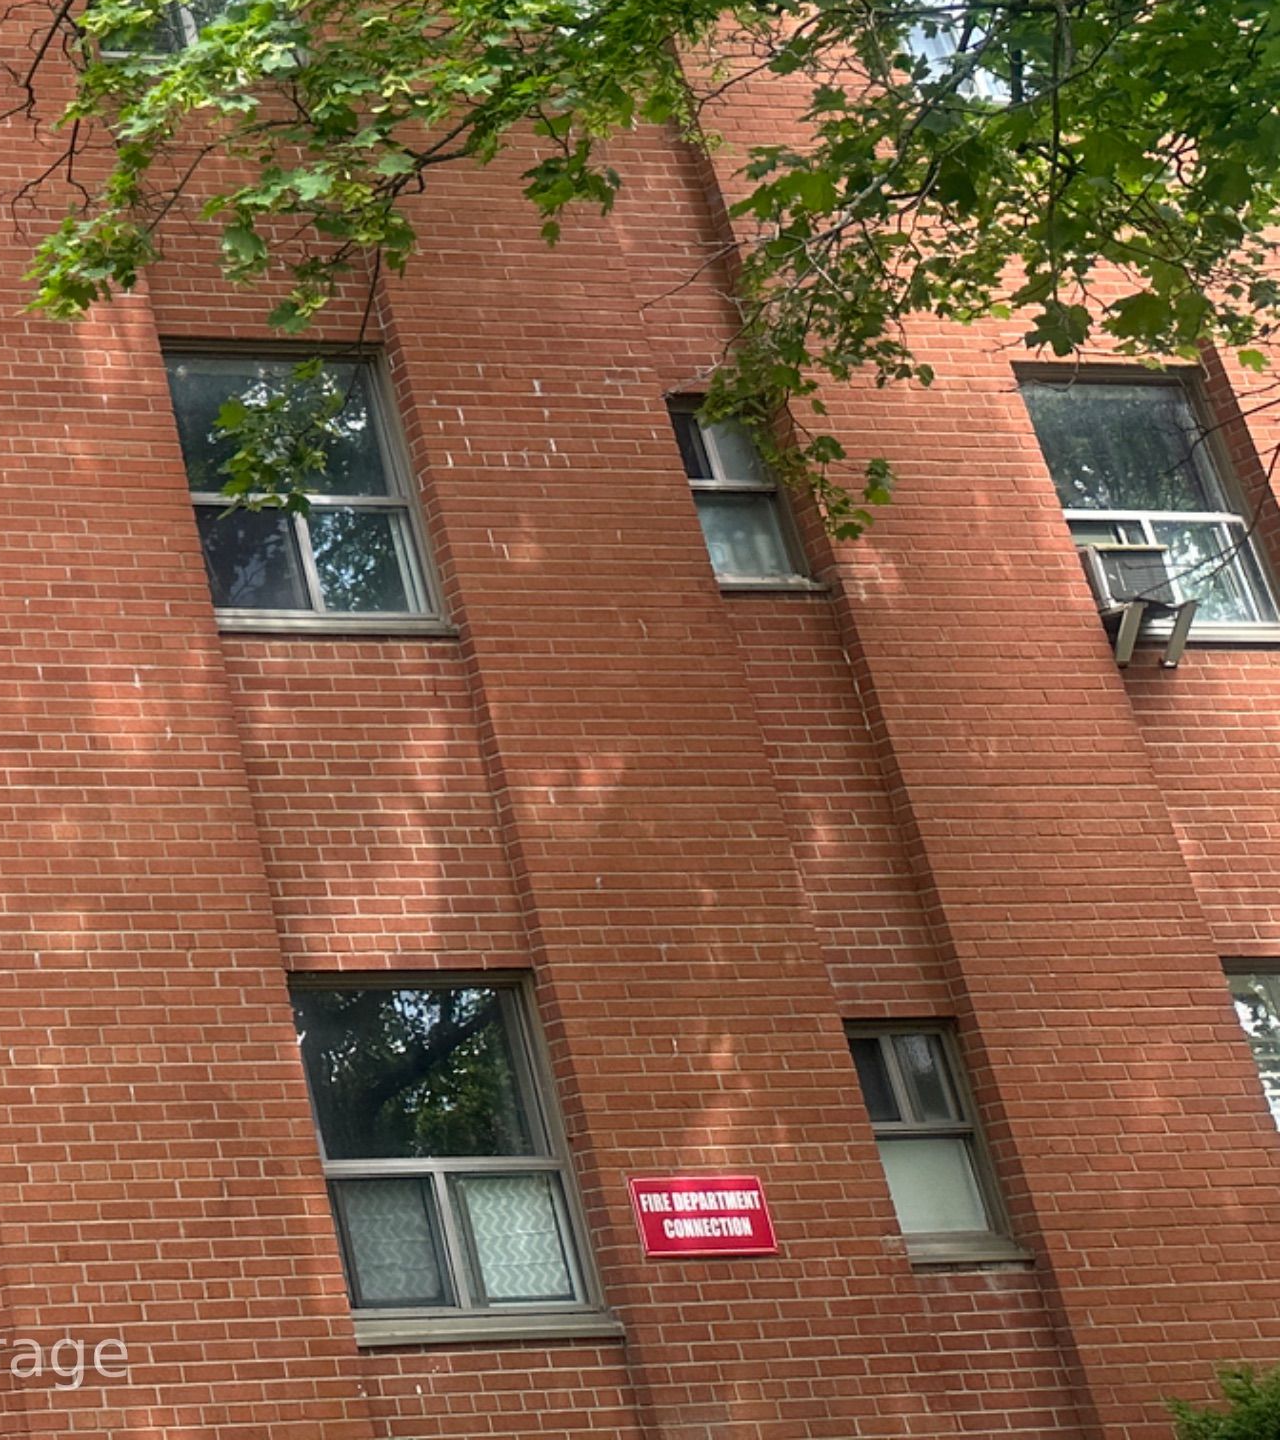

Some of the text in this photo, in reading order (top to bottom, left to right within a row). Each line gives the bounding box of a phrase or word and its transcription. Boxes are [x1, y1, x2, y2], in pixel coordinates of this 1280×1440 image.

[640, 1190, 761, 1213] FIRE DEPARTMENT
[662, 1216, 754, 1239] CONNECTION
